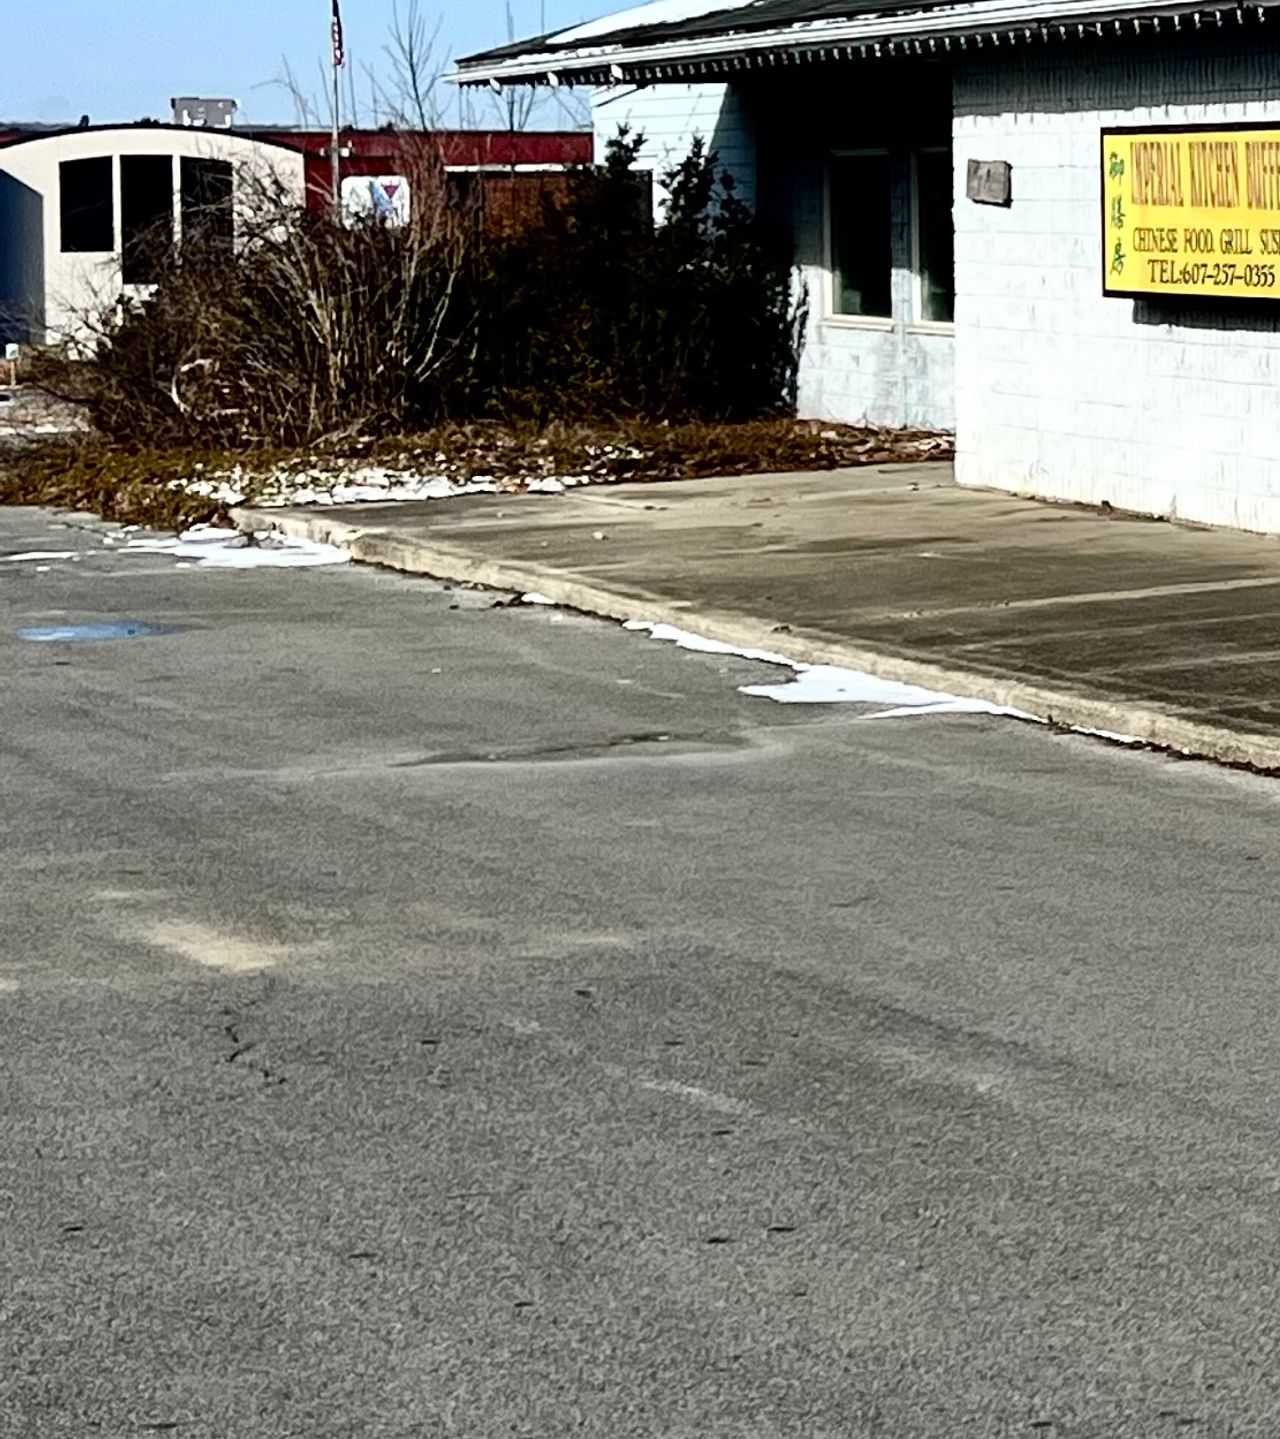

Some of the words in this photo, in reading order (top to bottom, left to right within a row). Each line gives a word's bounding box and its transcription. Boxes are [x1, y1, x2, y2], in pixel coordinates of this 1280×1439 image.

[1130, 141, 1183, 207] IMPERIAL
[1188, 141, 1240, 208] KITCHEN
[1133, 227, 1178, 253] CHINESE
[1220, 229, 1252, 255] GRILL
